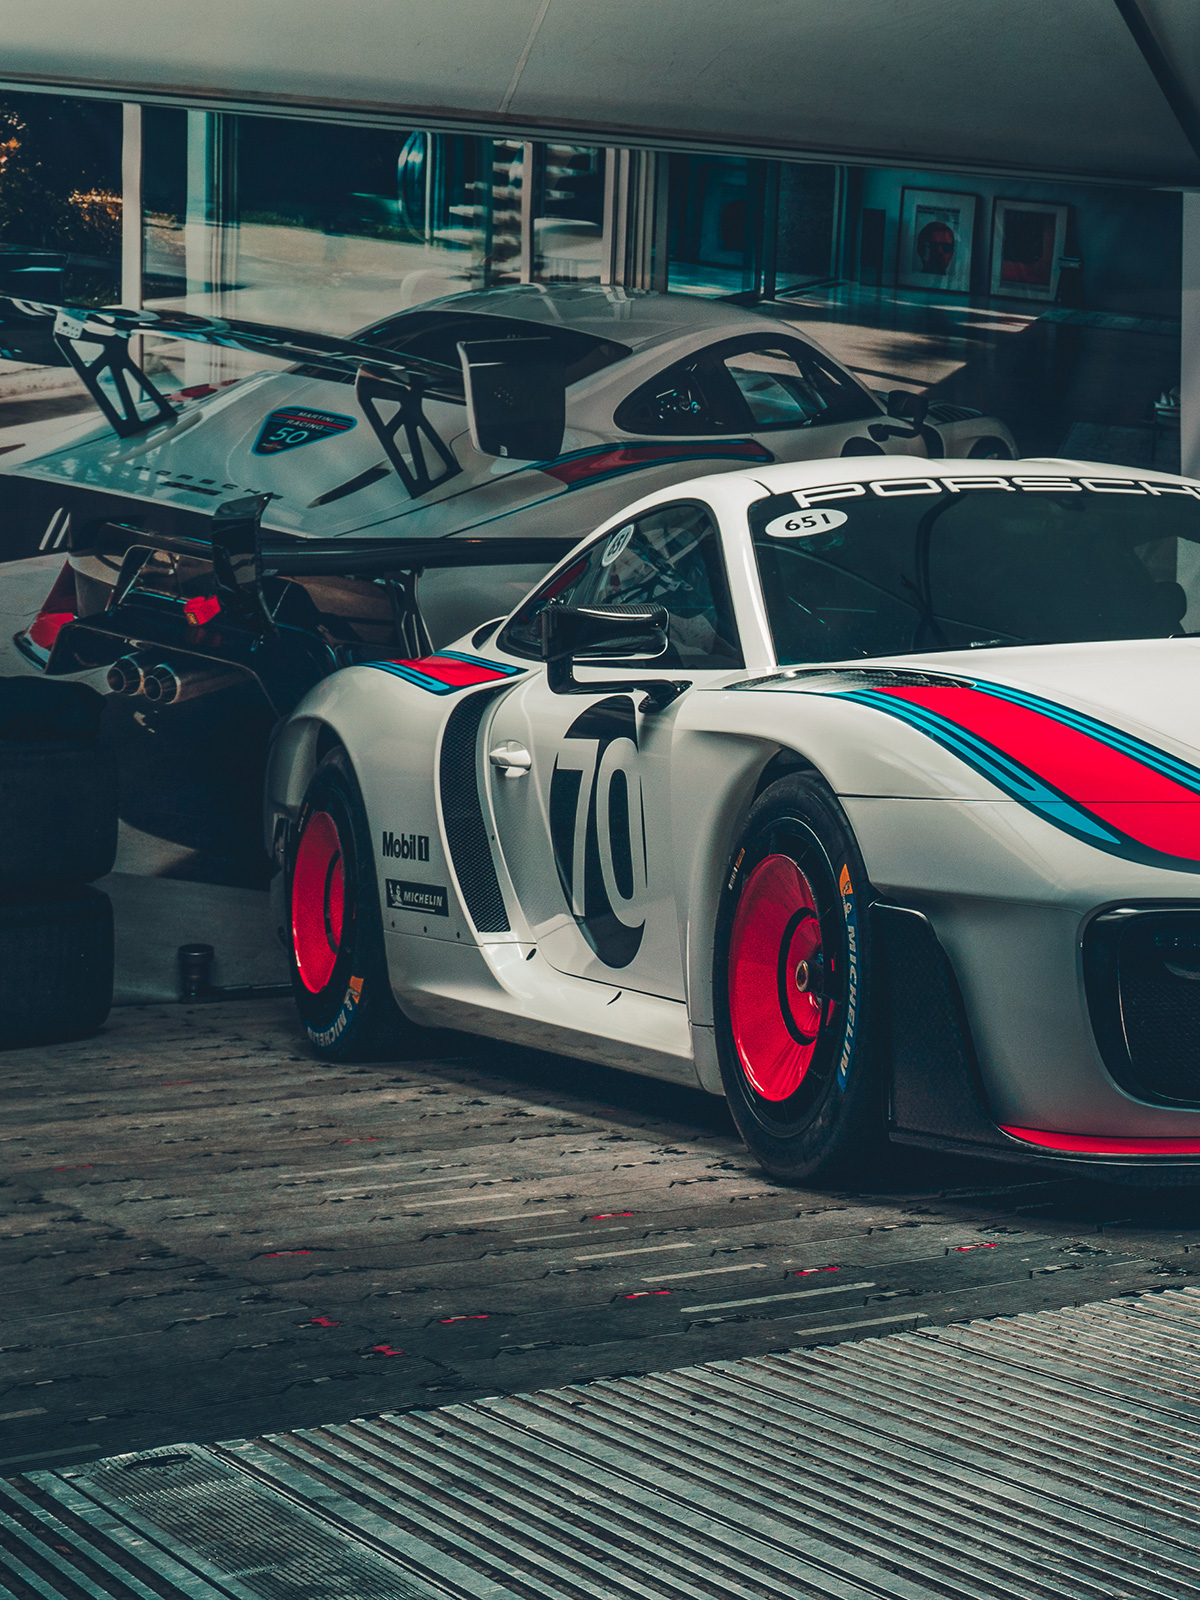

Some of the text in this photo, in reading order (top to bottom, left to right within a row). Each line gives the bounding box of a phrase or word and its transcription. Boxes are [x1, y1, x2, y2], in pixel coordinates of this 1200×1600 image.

[286, 419, 324, 430] RACING
[298, 411, 334, 423] MARTINI
[269, 427, 309, 444] 50
[784, 513, 831, 532] 651
[553, 736, 648, 928] 70
[382, 831, 417, 860] Mobil
[403, 890, 443, 907] MICHELIN
[840, 925, 857, 1077] MICHELIN
